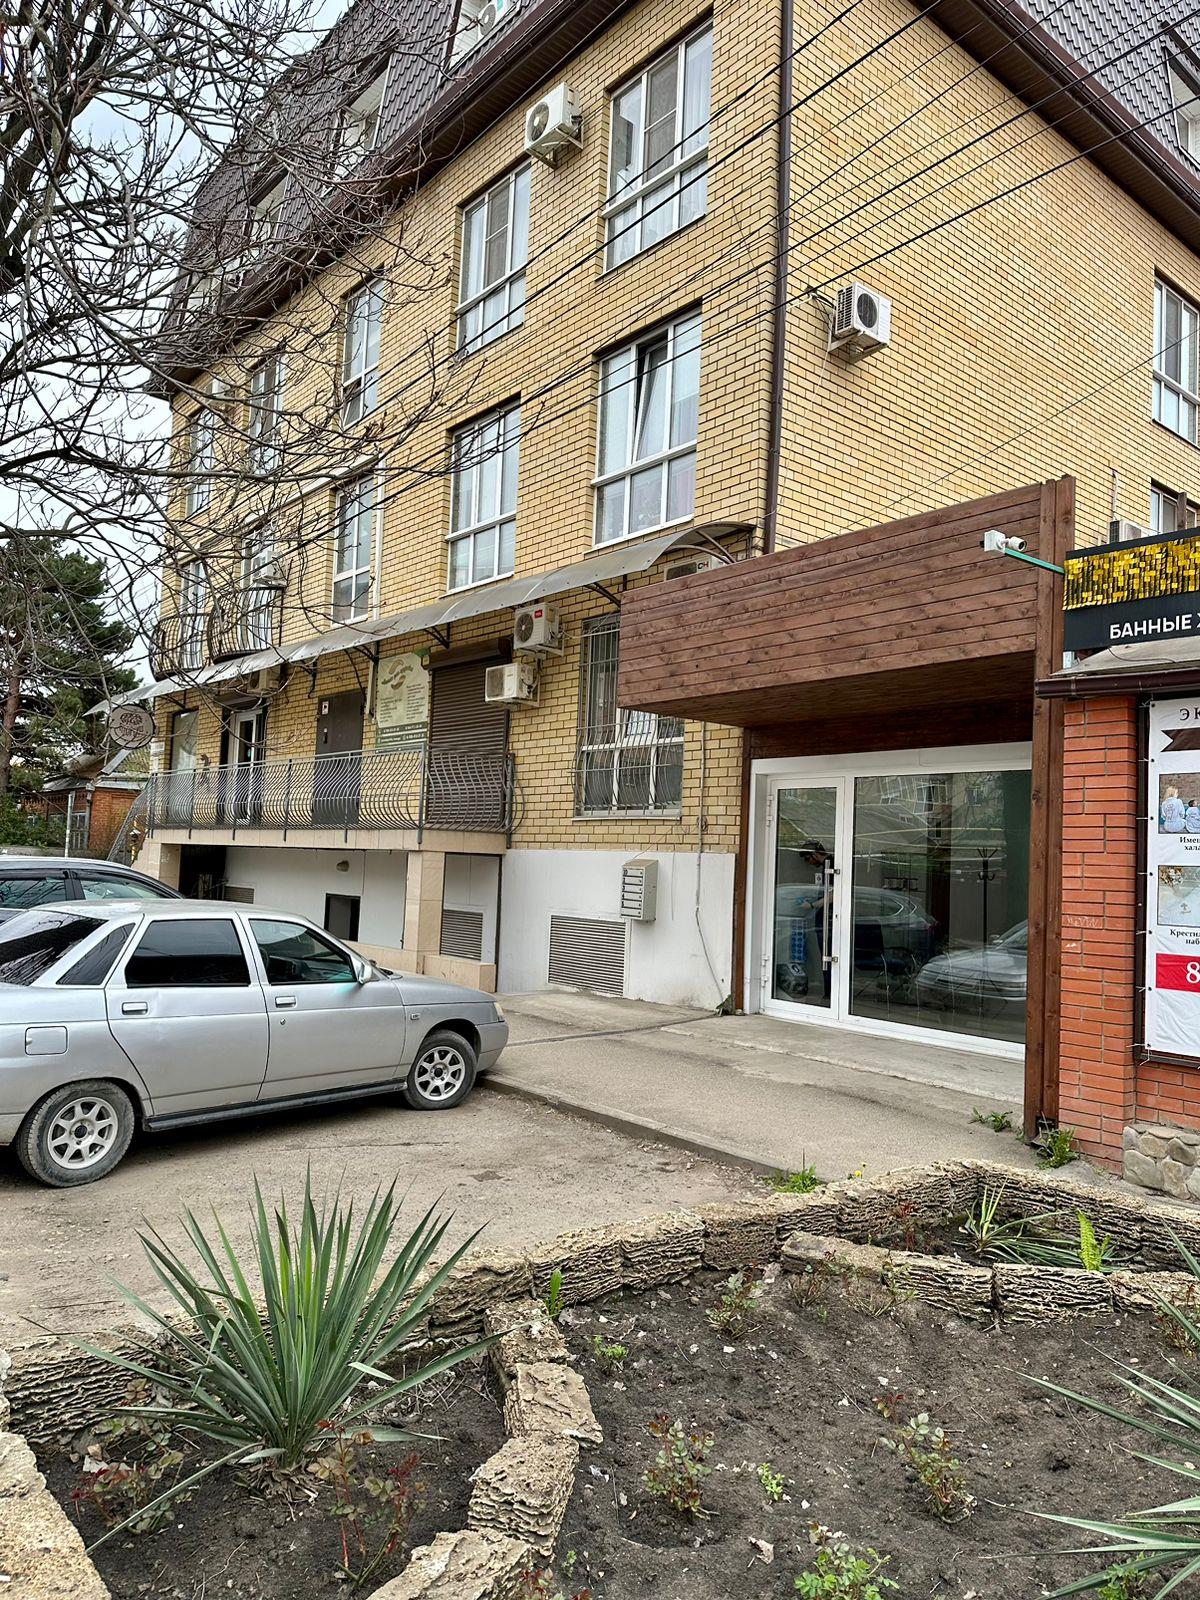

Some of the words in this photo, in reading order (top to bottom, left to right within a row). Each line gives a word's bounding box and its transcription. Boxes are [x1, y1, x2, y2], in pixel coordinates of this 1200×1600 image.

[1110, 614, 1192, 639] БАННЫЕ
[1169, 928, 1200, 938] Крести
[1186, 961, 1200, 984] 8
